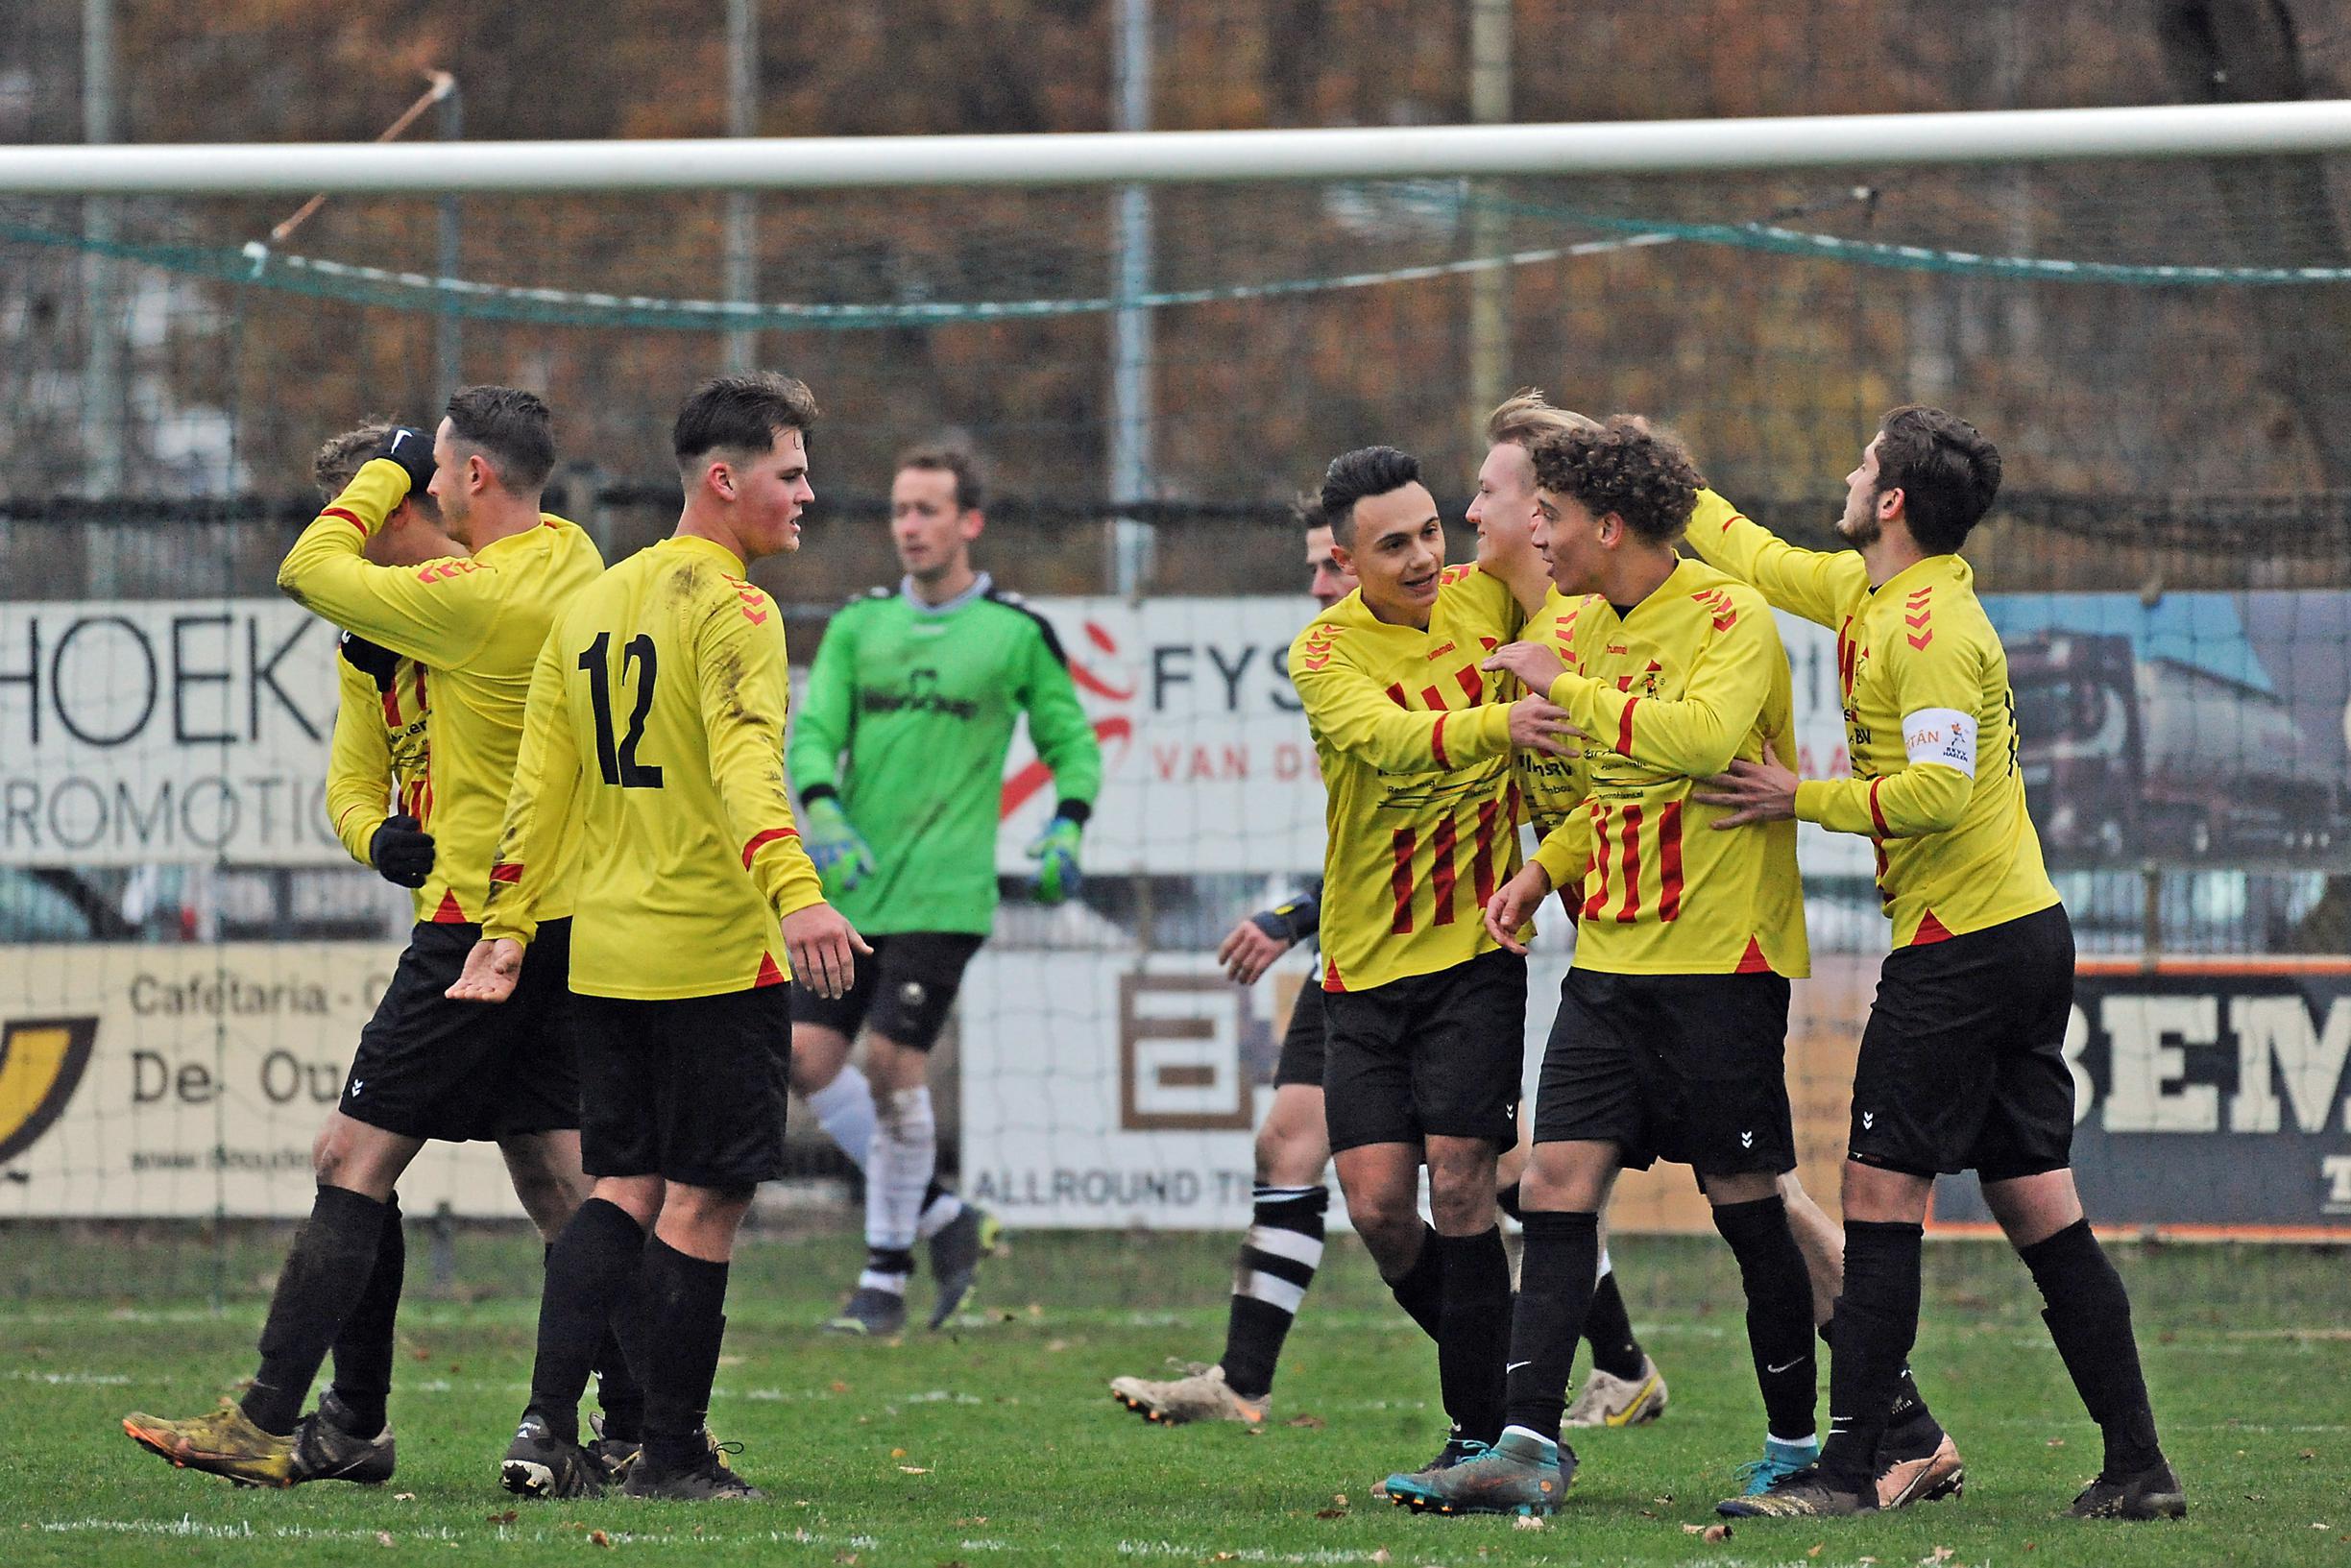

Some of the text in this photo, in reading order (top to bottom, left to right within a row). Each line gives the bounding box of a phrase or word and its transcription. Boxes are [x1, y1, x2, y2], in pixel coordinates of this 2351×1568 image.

[0, 615, 343, 746] HOEK
[578, 631, 664, 788] 12
[1152, 746, 1248, 781] VAN
[132, 1051, 213, 1103] De
[974, 1170, 1199, 1204] ALLROUND
